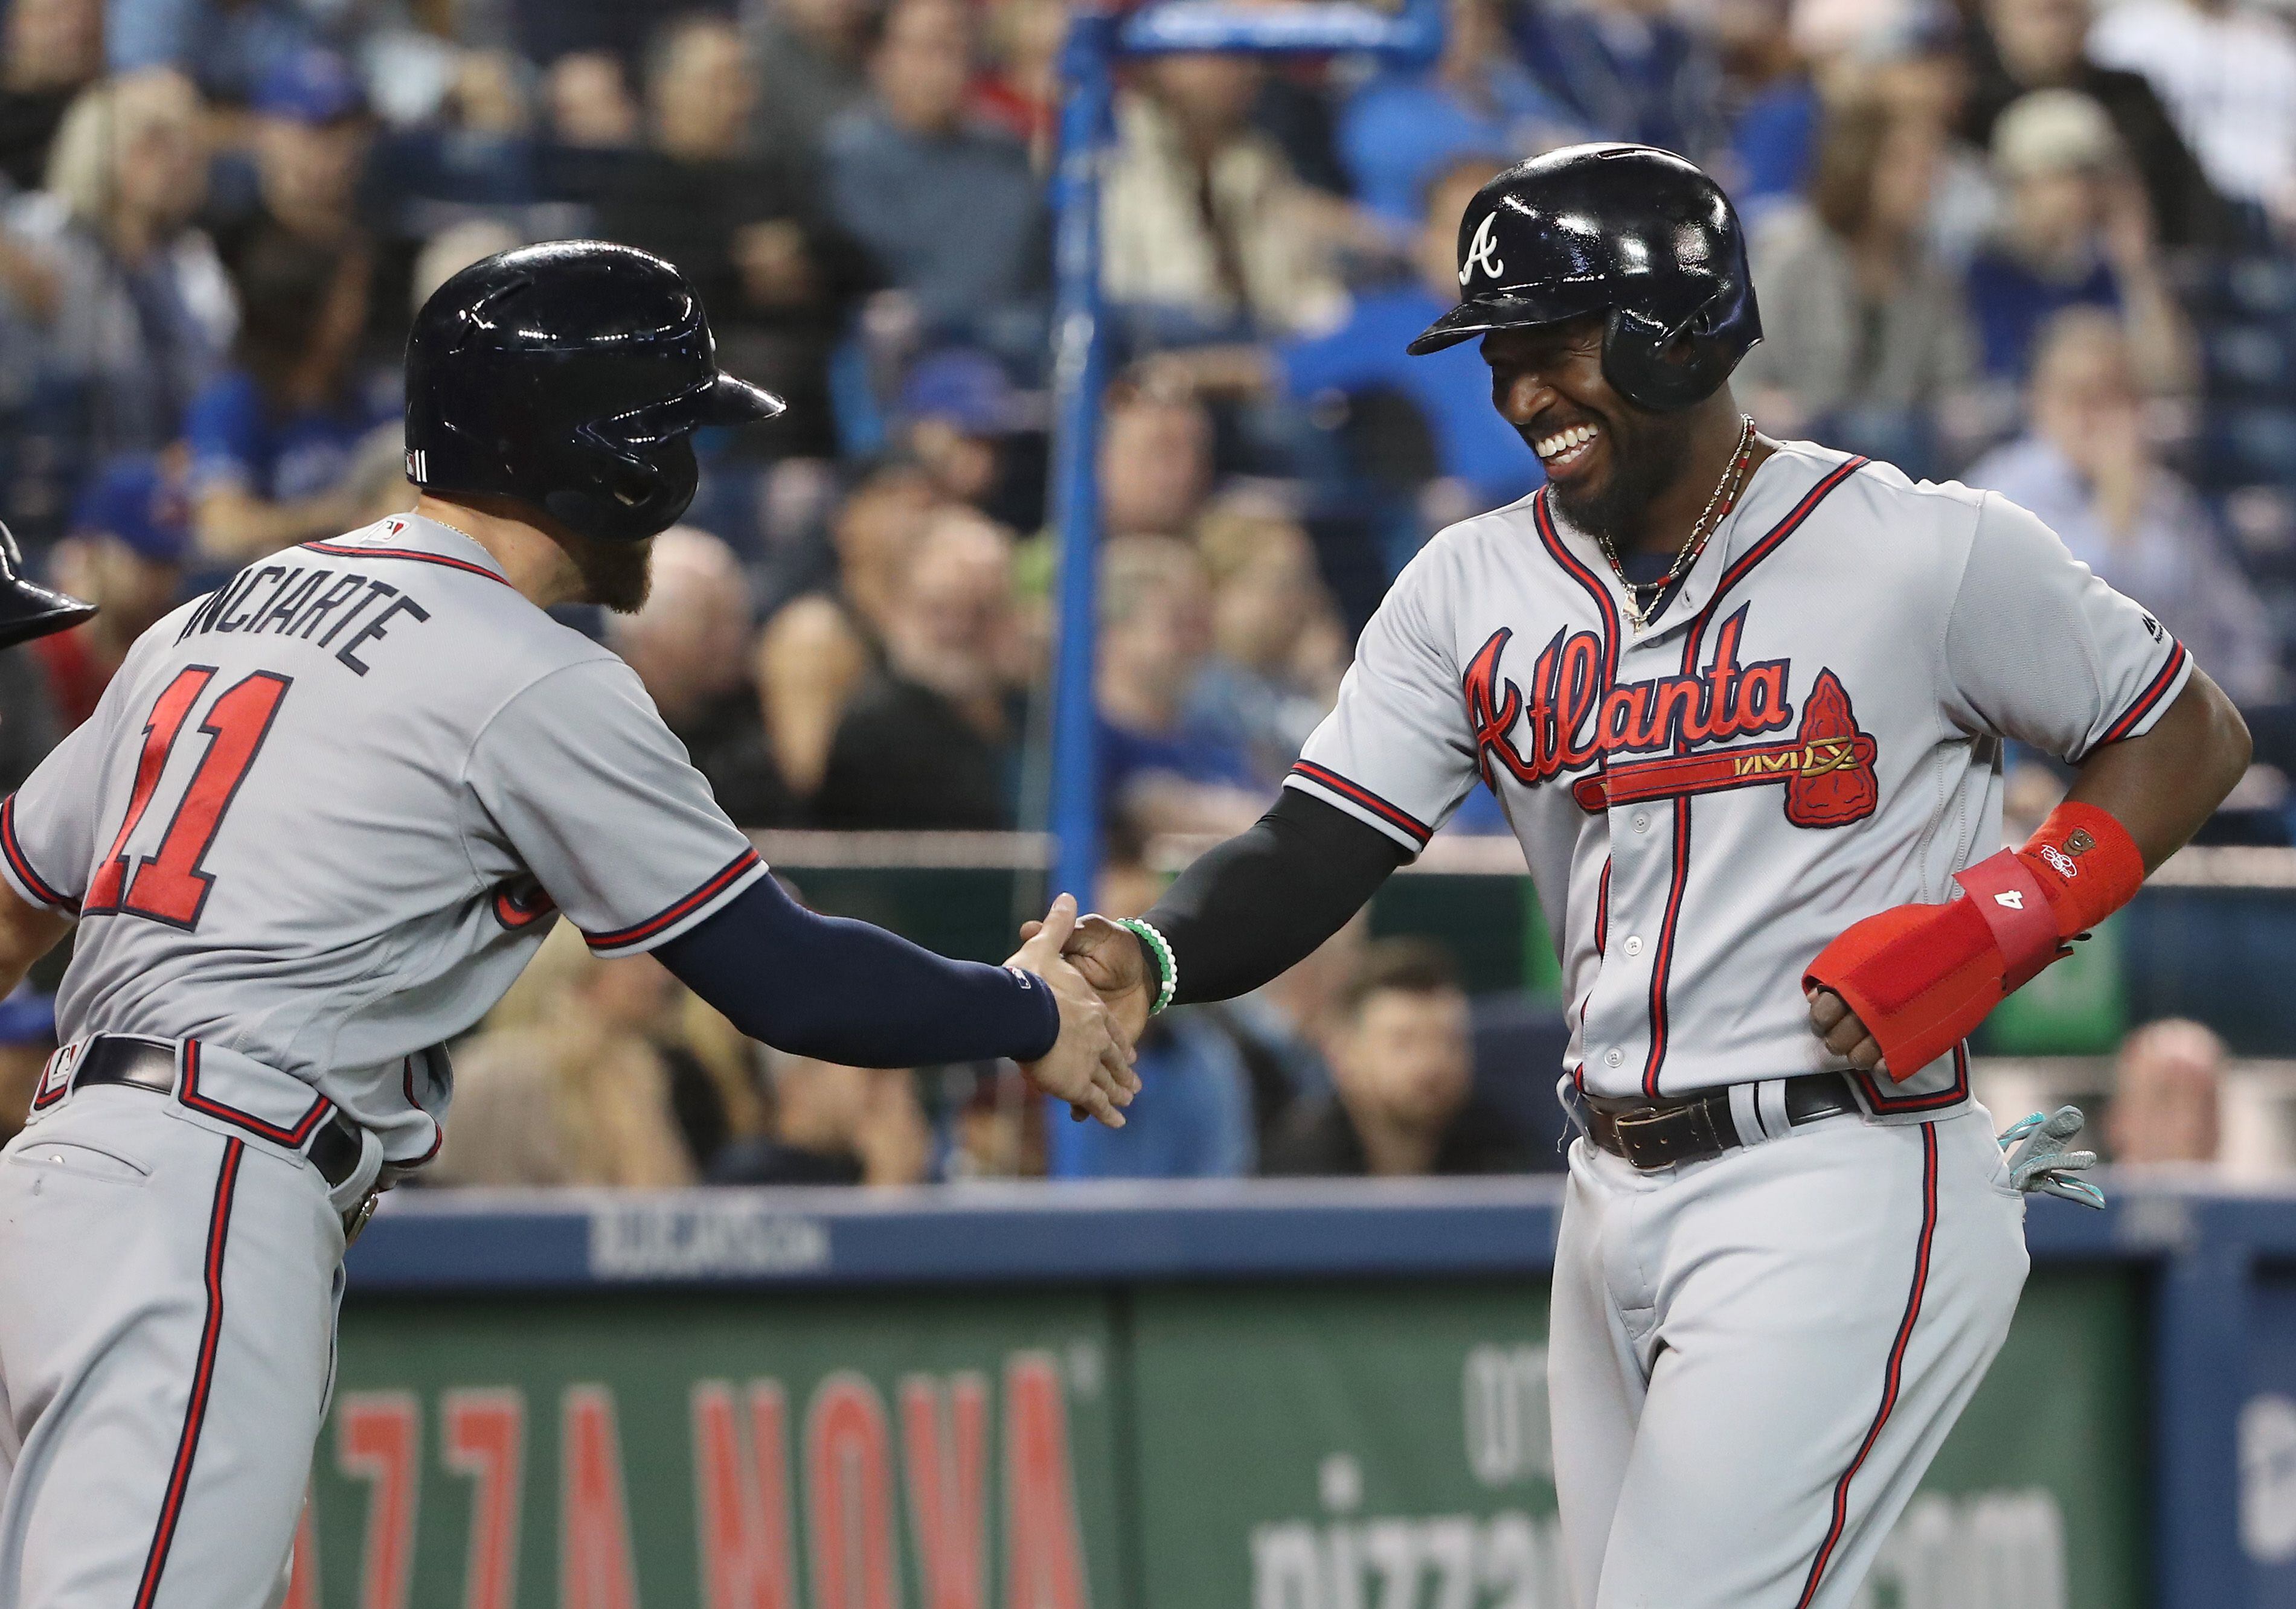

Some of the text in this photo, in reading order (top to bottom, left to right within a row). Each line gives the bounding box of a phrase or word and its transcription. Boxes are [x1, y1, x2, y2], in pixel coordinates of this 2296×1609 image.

[1458, 211, 1504, 286] A
[1463, 600, 1794, 796] Atlanta
[80, 664, 294, 933] 11
[1993, 890, 2024, 910] 4
[689, 1349, 1087, 1609] NOVA
